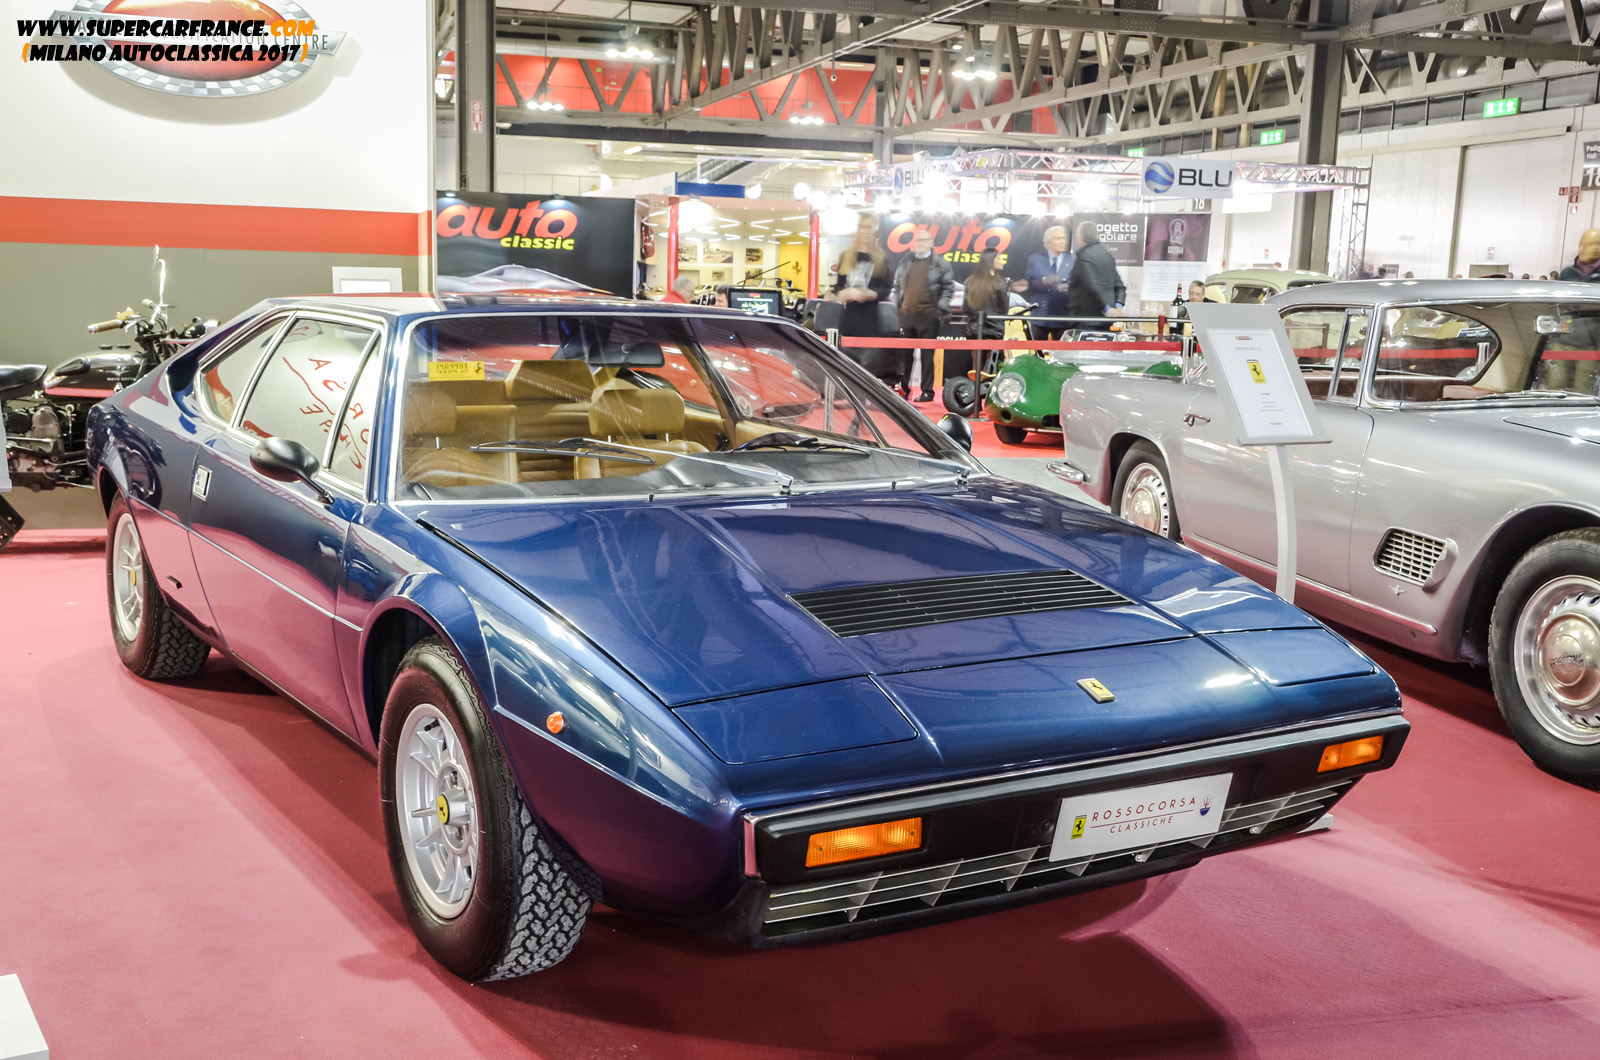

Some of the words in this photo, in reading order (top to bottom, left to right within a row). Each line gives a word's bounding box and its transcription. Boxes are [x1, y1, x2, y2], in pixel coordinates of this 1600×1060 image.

[904, 168, 925, 188] BLU
[1178, 168, 1233, 188] BLU
[436, 200, 578, 240] auto
[1096, 222, 1139, 234] ogetto
[501, 235, 575, 250] classic
[886, 218, 1012, 255] auto
[943, 250, 1008, 265] clasc
[1091, 797, 1196, 822] ROSSOCORSA
[1109, 816, 1174, 834] CLASSICHE
